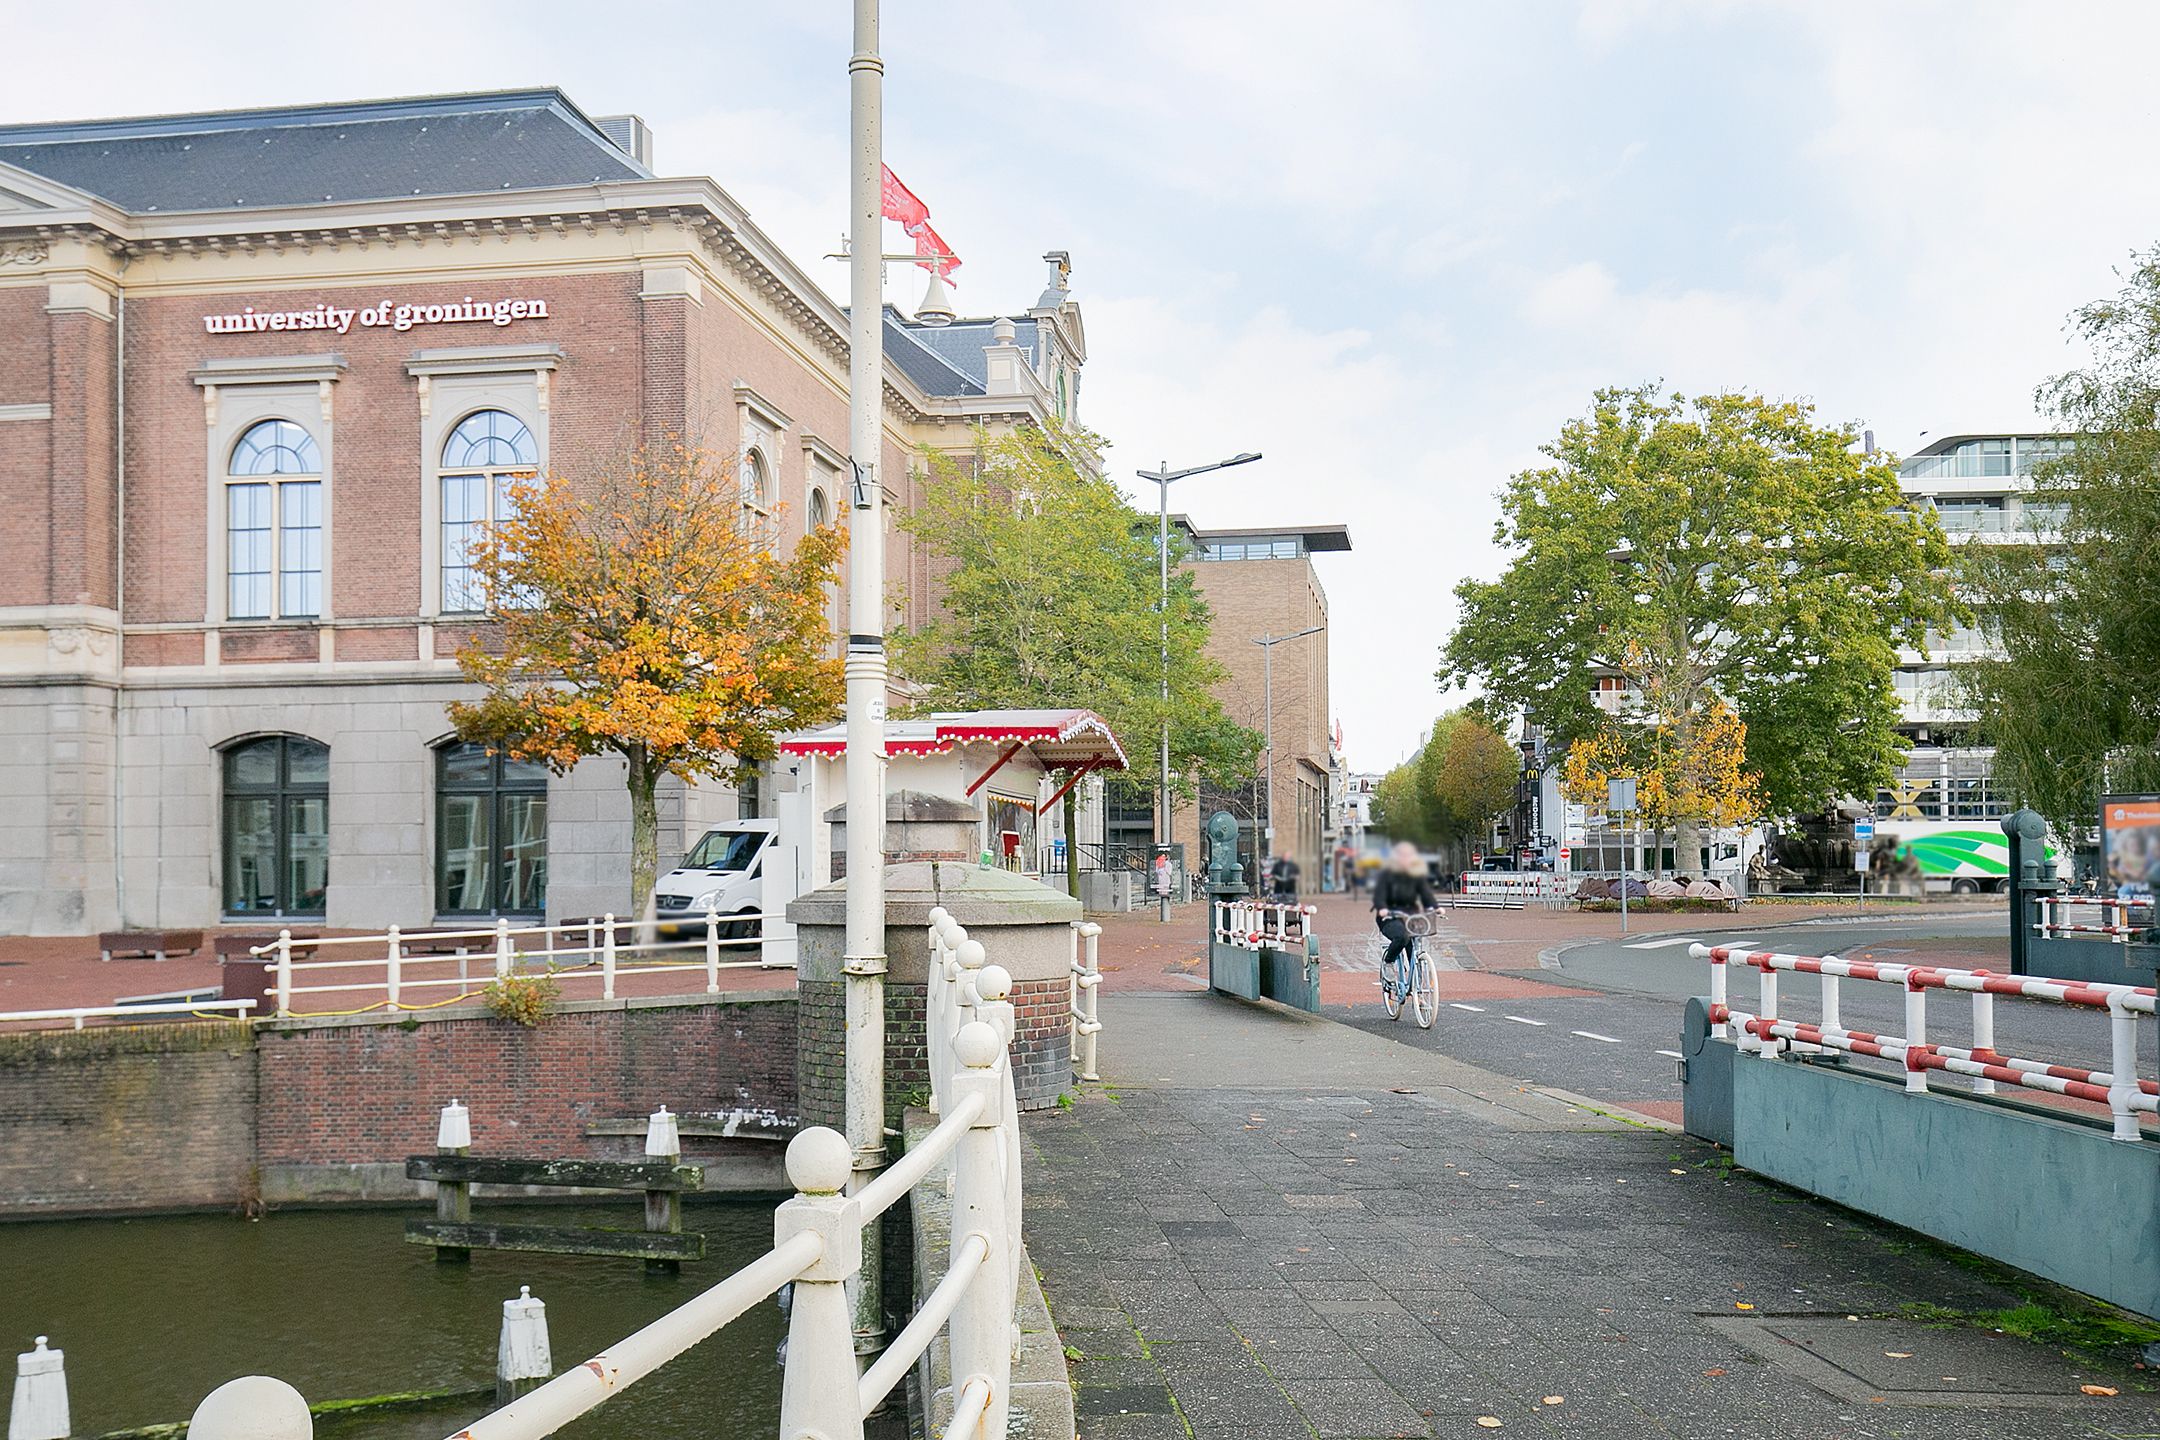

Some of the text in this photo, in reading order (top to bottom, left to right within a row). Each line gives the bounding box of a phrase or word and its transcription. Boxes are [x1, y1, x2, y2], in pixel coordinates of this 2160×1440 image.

[203, 296, 550, 335] university of groningen
